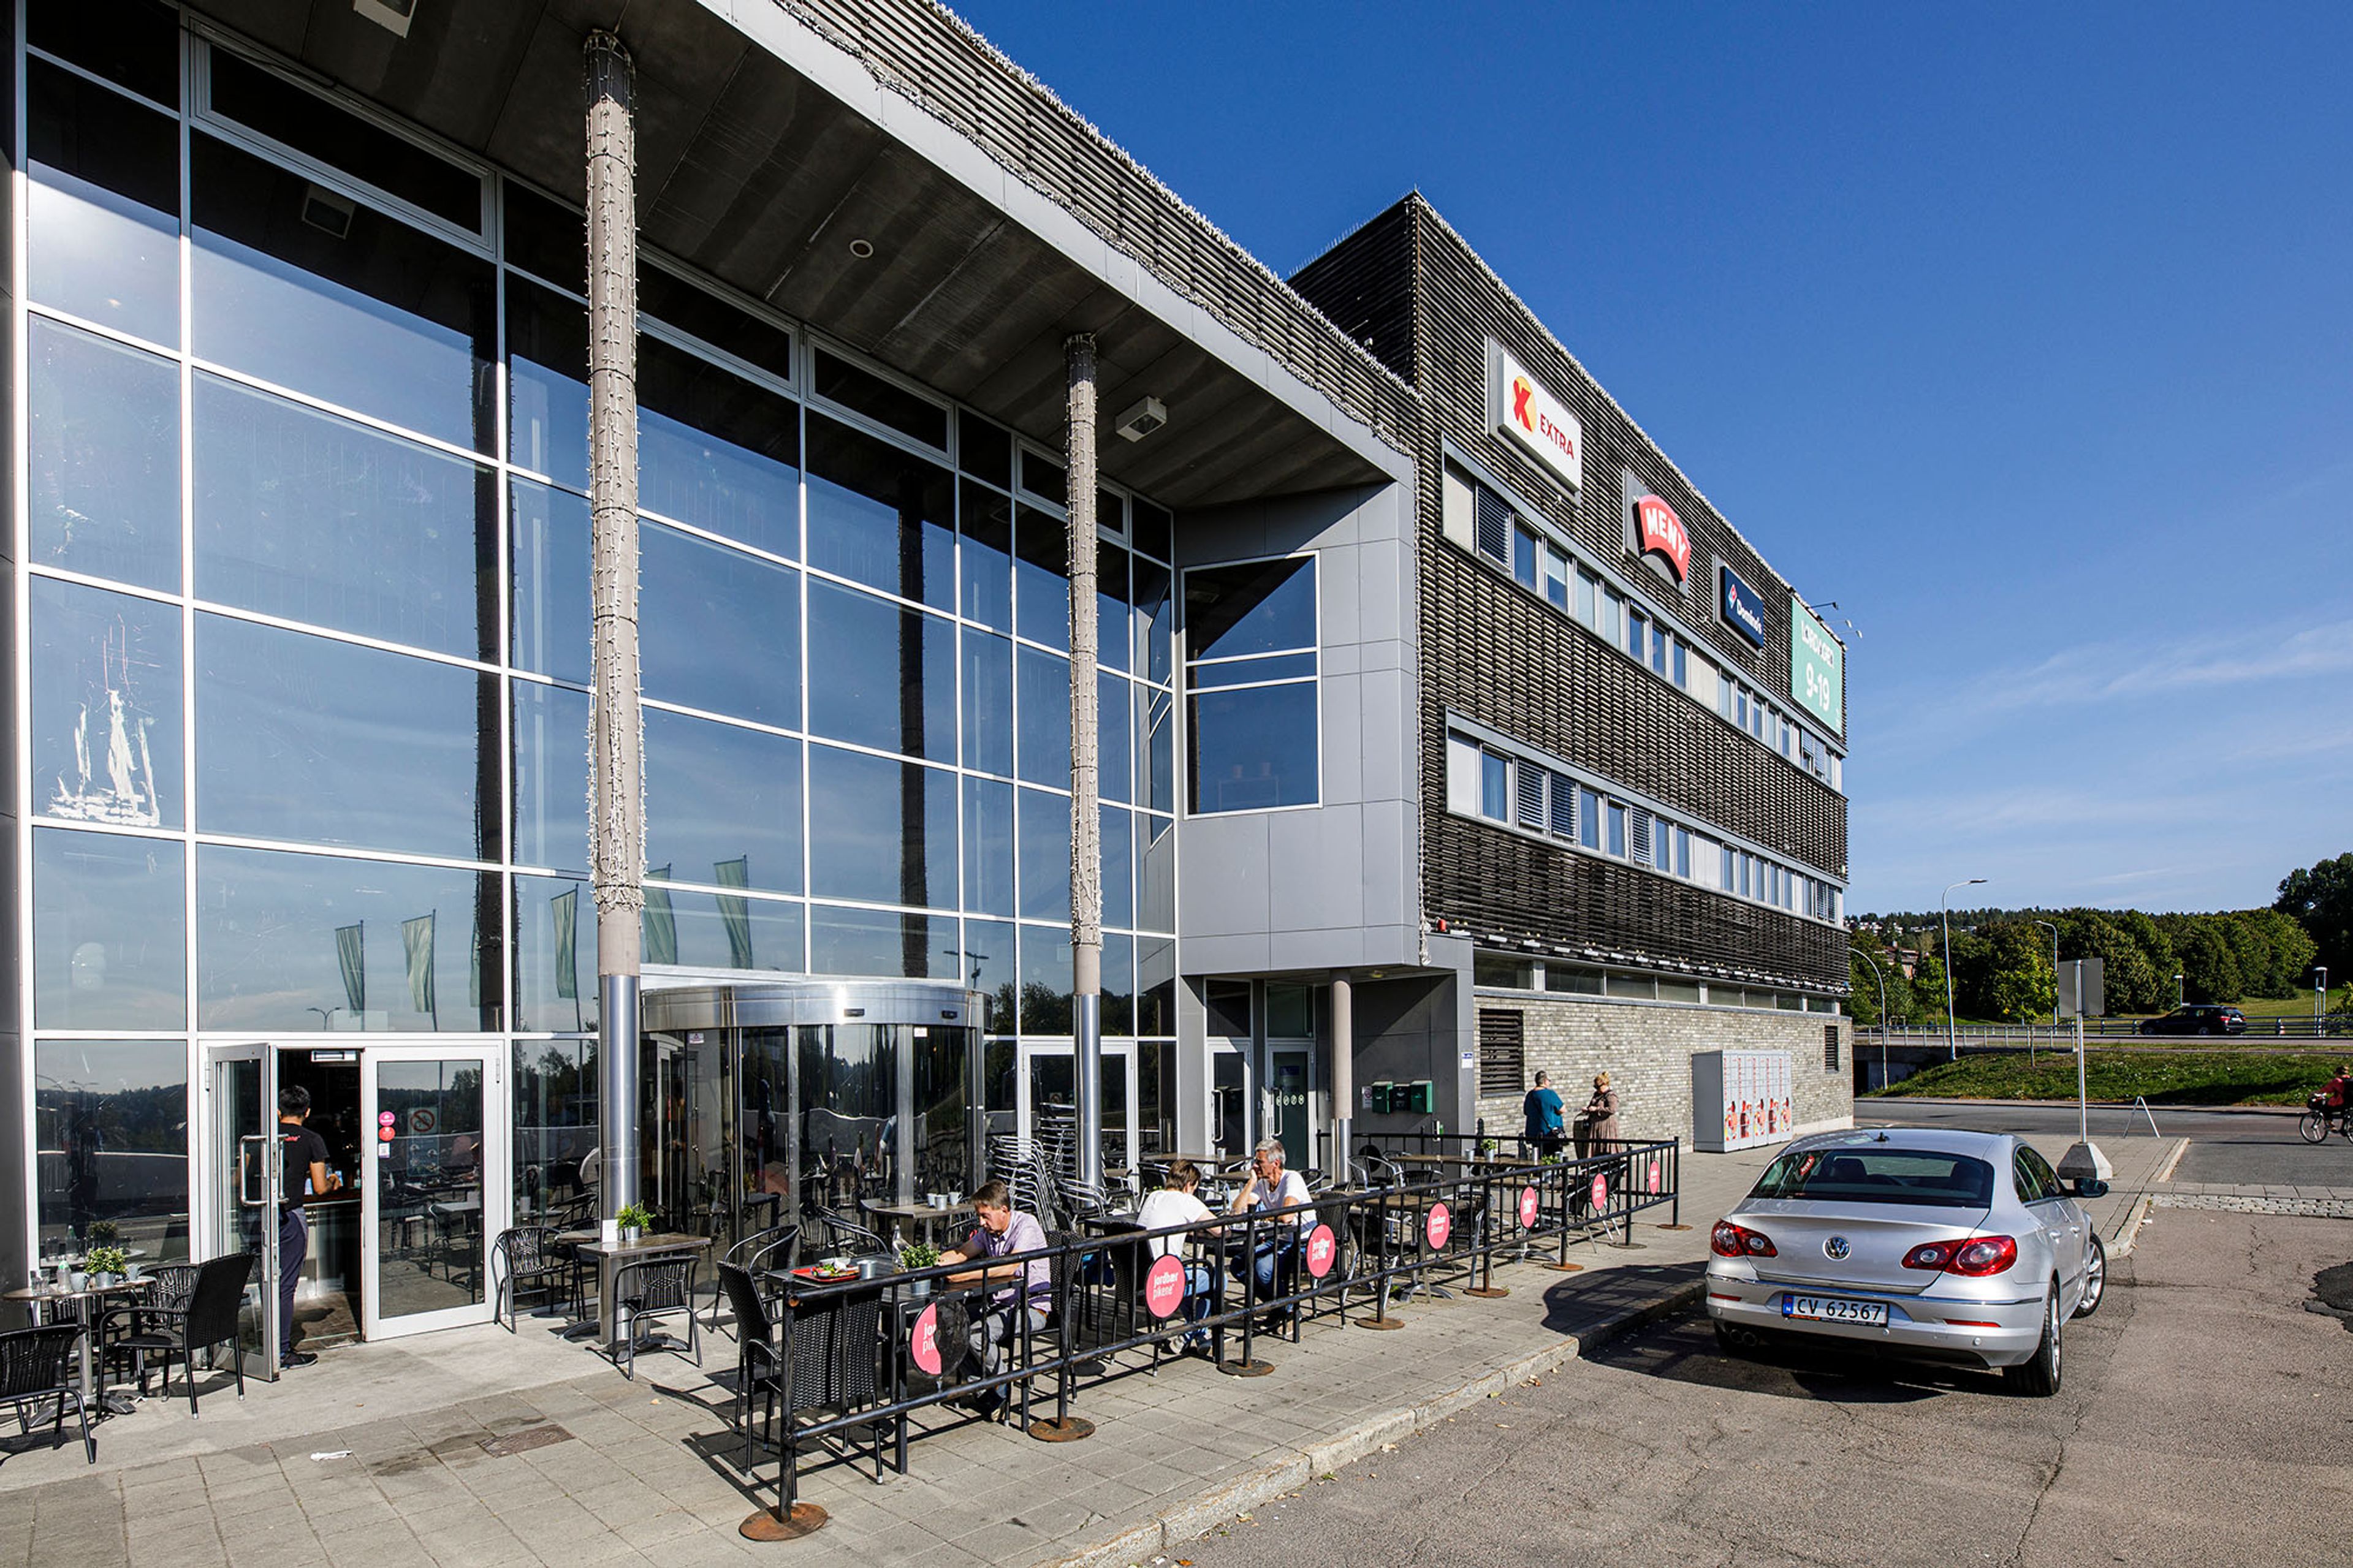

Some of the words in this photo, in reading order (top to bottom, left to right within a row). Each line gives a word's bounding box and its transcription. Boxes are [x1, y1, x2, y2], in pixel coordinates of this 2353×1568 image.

[1540, 412, 1574, 460] EXTRA
[1645, 507, 1687, 561] MENY
[1806, 662, 1830, 712] 9-19
[1797, 1298, 1819, 1314] CV
[1826, 1301, 1882, 1320] 62567
